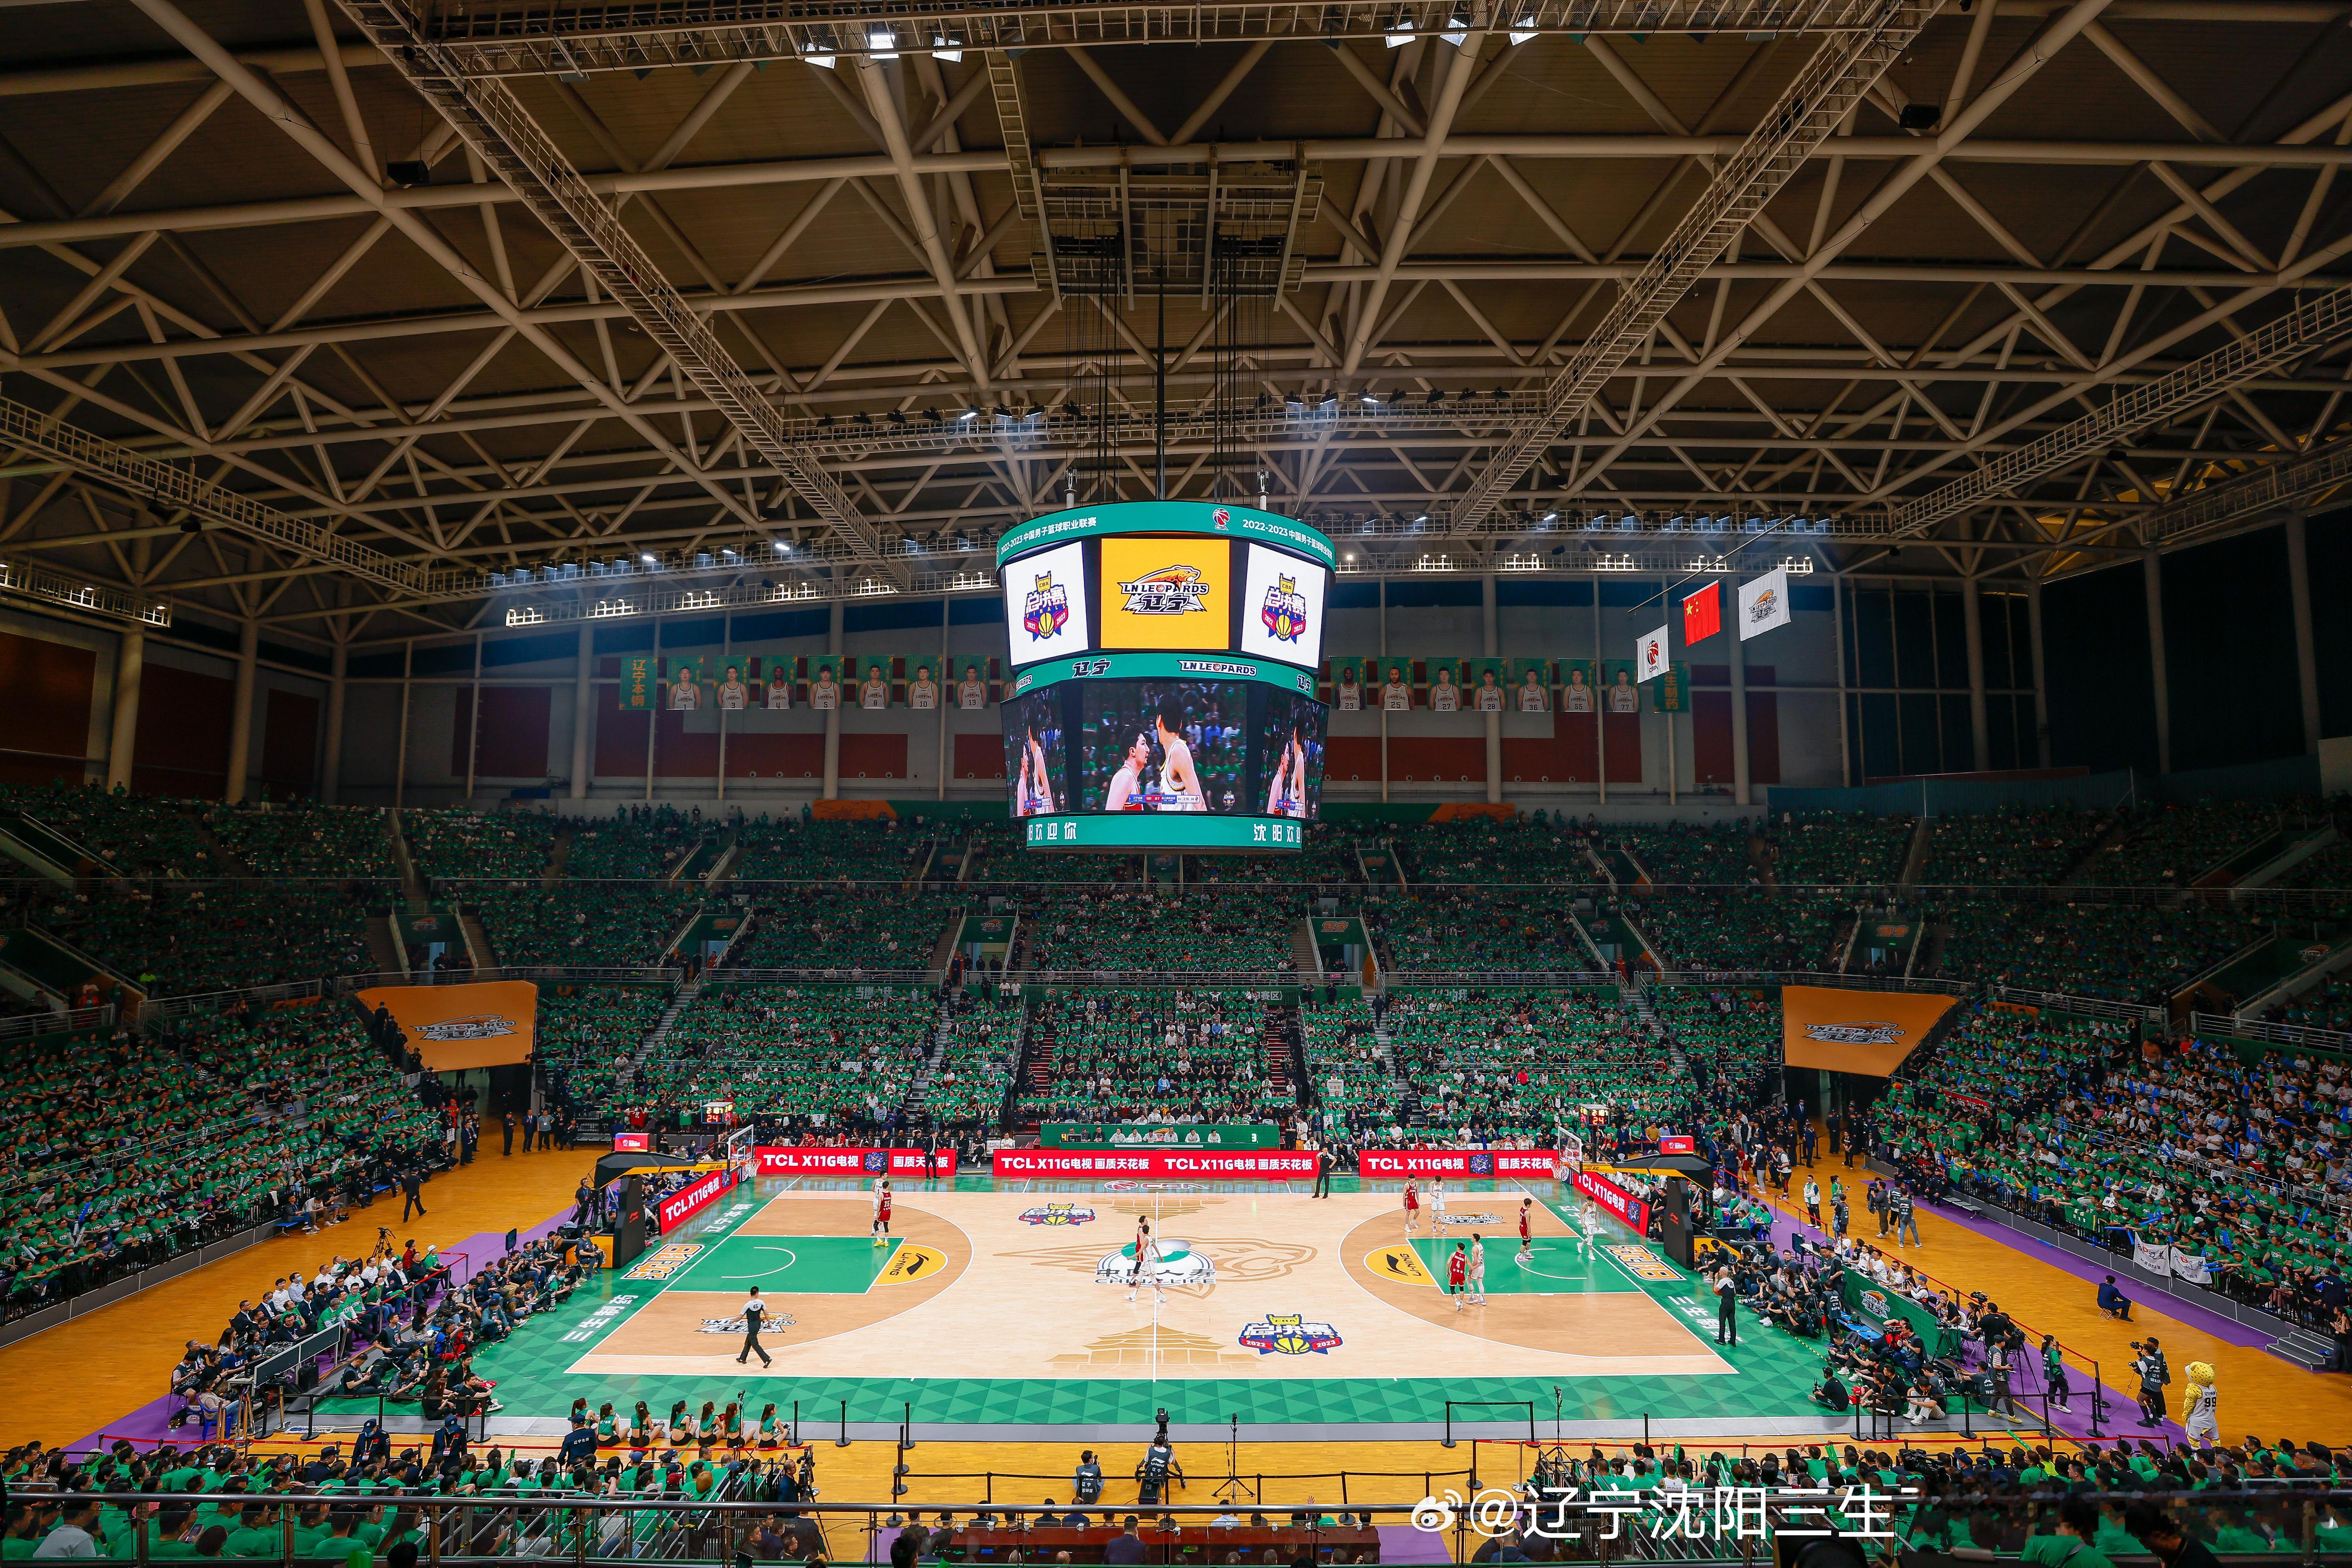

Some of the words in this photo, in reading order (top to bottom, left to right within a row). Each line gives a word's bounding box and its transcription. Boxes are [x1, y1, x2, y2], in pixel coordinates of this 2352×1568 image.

[1242, 519, 1288, 537] 2022-2023
[1001, 536, 1023, 555] 2022-2023
[1023, 517, 1097, 542] 中国男子篮球职业联赛
[1026, 586, 1066, 614] 总决赛
[1265, 588, 1305, 616] 总决赛
[1027, 604, 1065, 618] FINALS
[1265, 606, 1304, 621] FINALS
[1056, 612, 1066, 625] 2023
[1265, 614, 1273, 626] 2022
[1027, 622, 1036, 630] 2022
[1293, 624, 1303, 633] 2023
[1199, 663, 1255, 675] LEOPARDS
[631, 660, 646, 707] 辽宁本钢
[707, 1114, 718, 1123] 24
[1593, 1117, 1604, 1125] 24
[1251, 1133, 1257, 1142] 3
[763, 1155, 799, 1166] TCL
[802, 1155, 859, 1167] X11G电视
[1001, 1158, 1035, 1169] TCL
[1037, 1158, 1092, 1169] X11G电视
[1095, 1158, 1149, 1170] 画质天花板
[1164, 1159, 1199, 1170] TCL
[1200, 1159, 1255, 1170] X11G电视
[1258, 1159, 1312, 1170] 画质天花板
[1368, 1158, 1404, 1170] TCL
[1407, 1158, 1464, 1170] X11G电视
[1498, 1157, 1553, 1170] 画质天花板
[665, 1200, 689, 1221] TCL
[688, 1178, 720, 1205] X11G电视
[1593, 1182, 1626, 1213] X11G电视
[889, 1253, 912, 1276] LI-NING
[1400, 1253, 1422, 1276] LI-NING
[1456, 1260, 1460, 1268] 4
[561, 1295, 639, 1342] 三生制药
[1244, 1323, 1334, 1336] 总决赛
[1317, 1339, 1337, 1347] 2023
[2205, 1397, 2216, 1407] 99
